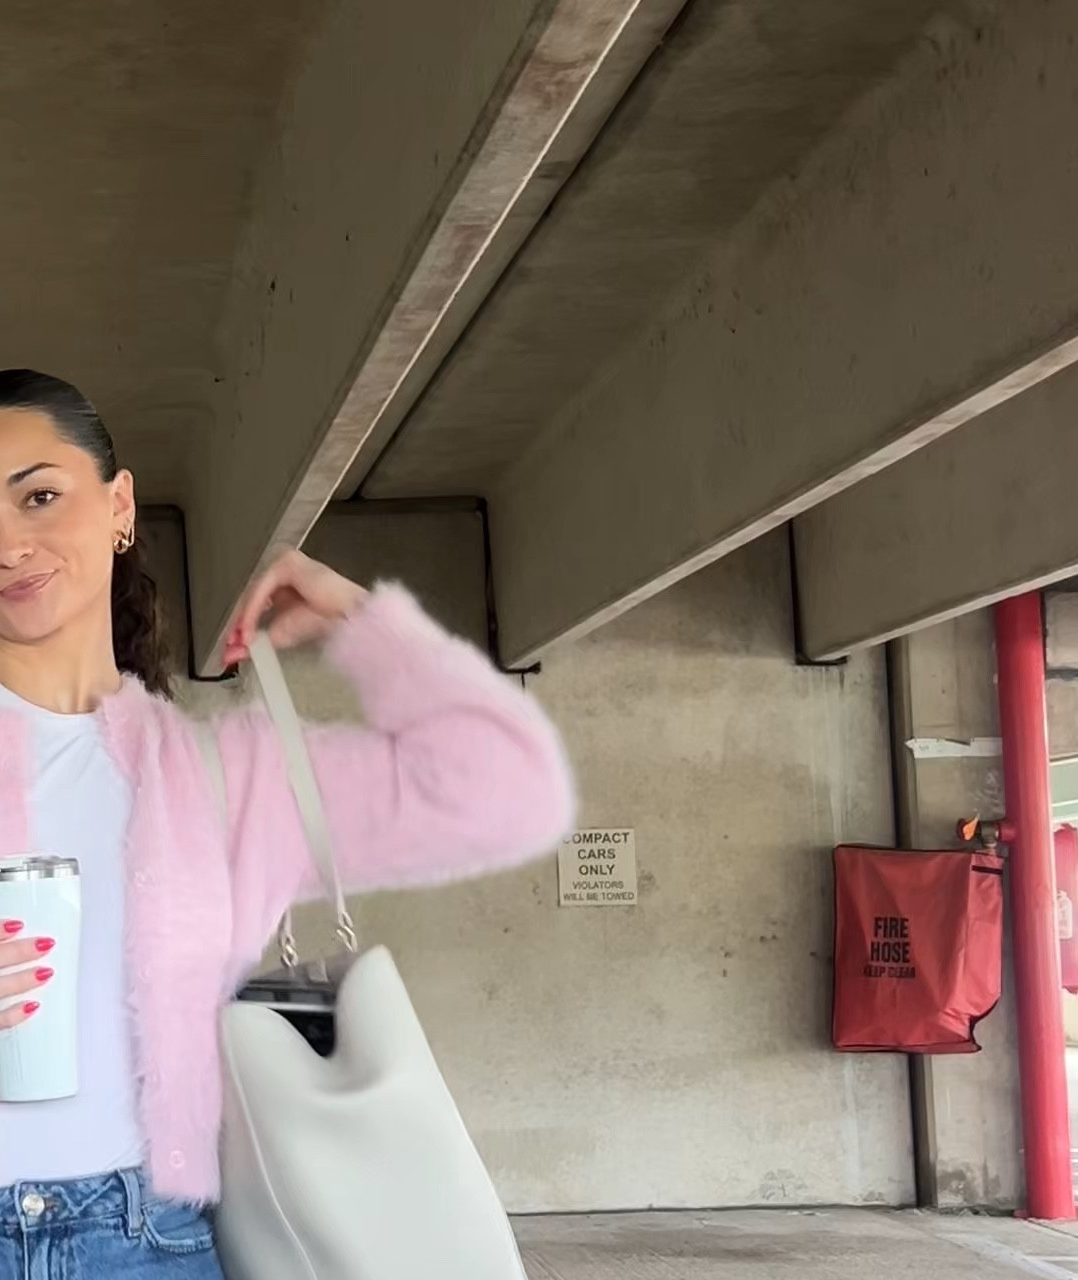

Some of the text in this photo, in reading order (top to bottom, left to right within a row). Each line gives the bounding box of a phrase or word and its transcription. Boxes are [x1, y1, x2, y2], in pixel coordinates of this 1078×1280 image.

[577, 848, 616, 860] CARS
[578, 864, 616, 876] ONLY
[572, 881, 624, 890] VIOLATORS
[601, 891, 635, 901] TOWED
[874, 917, 909, 938] FIRE
[871, 941, 911, 963] HOSE
